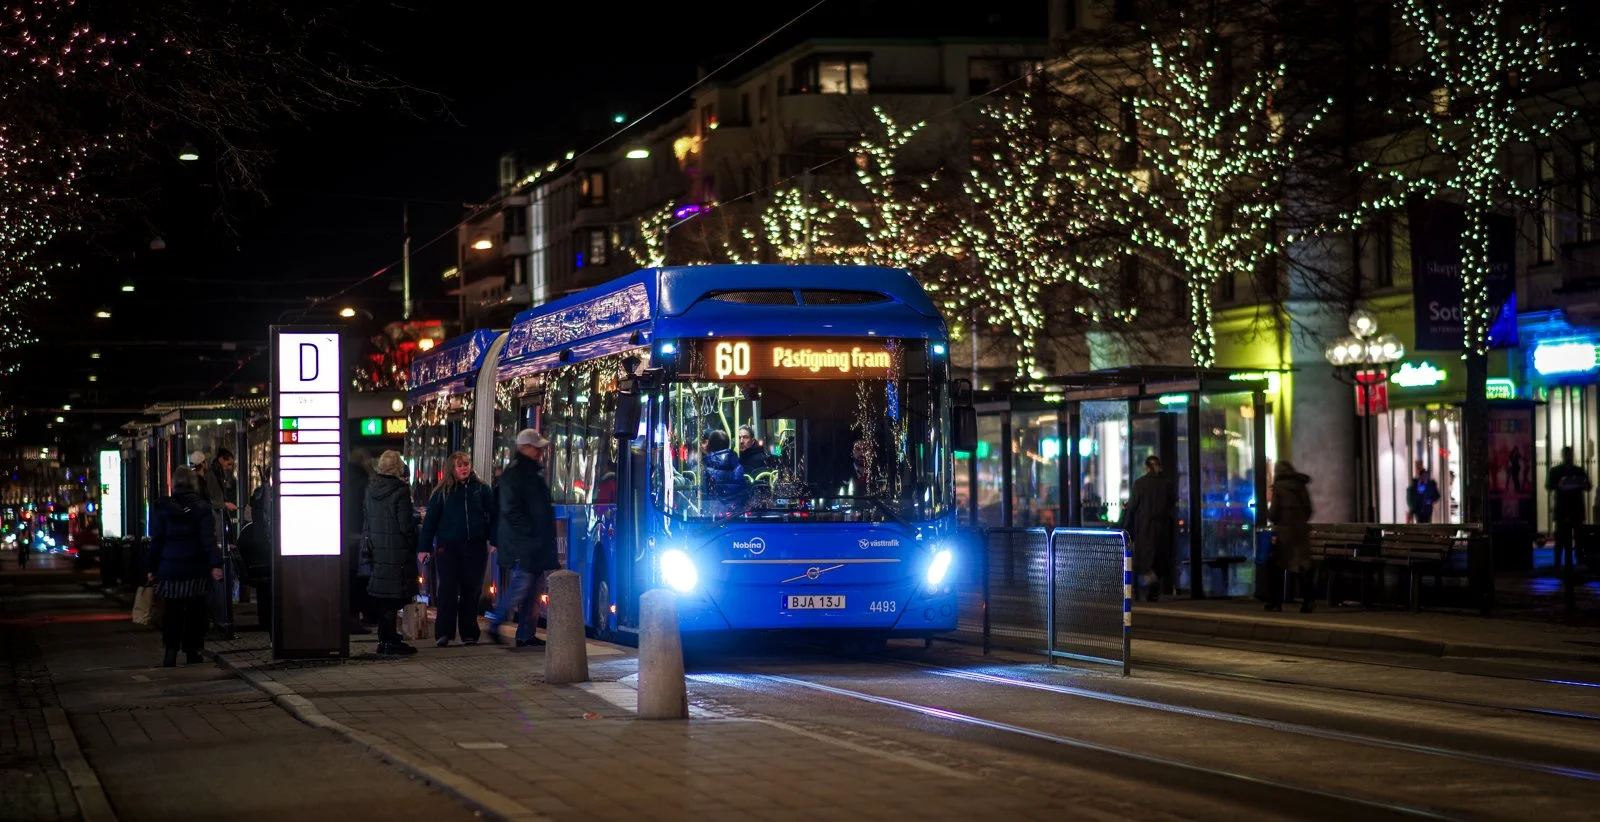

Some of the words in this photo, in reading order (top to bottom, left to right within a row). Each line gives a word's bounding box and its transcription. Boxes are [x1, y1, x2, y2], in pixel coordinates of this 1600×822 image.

[299, 343, 319, 382] D
[715, 341, 751, 378] 60
[773, 346, 850, 373] Påstigning
[851, 347, 891, 368] fram
[291, 419, 298, 428] 4
[367, 419, 376, 434] 4
[291, 432, 298, 442] 5
[733, 541, 762, 550] Nobina
[870, 539, 900, 548] västtrafik
[792, 596, 815, 608] BJA
[819, 596, 841, 608] 13J
[869, 600, 896, 613] 4493
